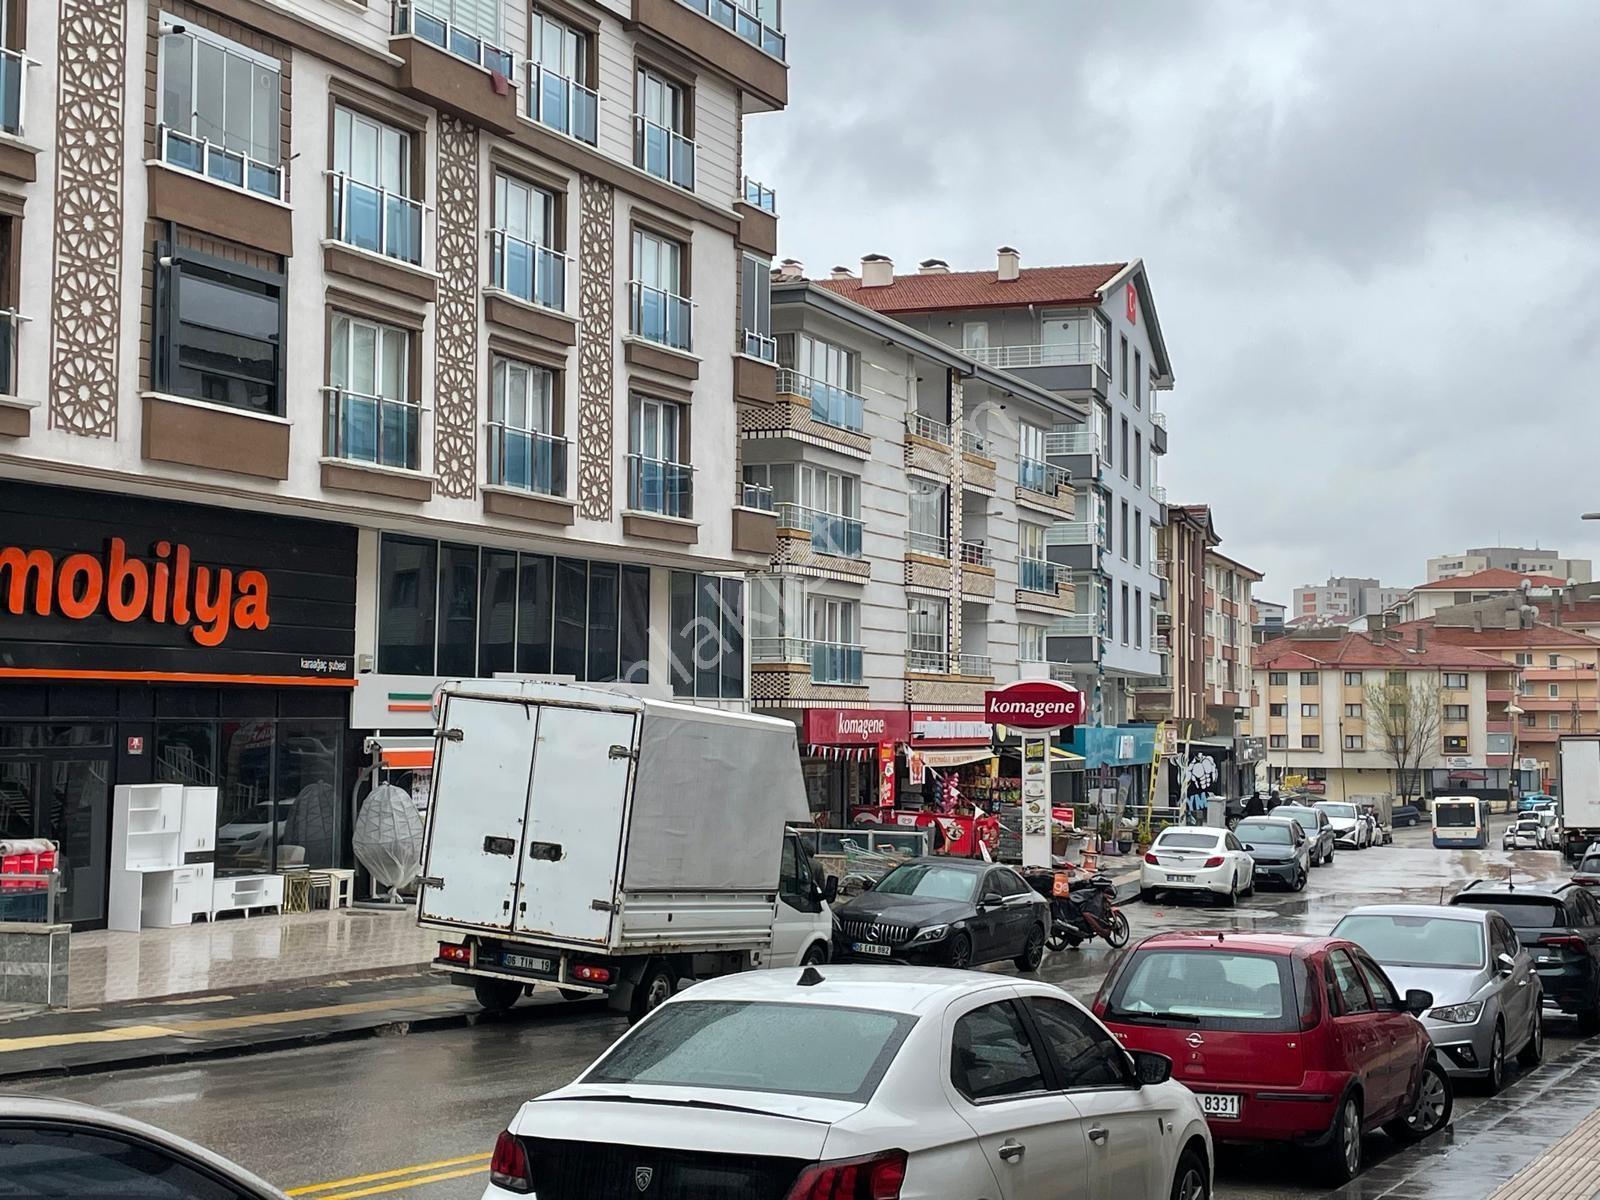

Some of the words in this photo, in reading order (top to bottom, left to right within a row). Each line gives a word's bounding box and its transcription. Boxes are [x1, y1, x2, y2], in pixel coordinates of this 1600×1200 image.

[0, 537, 271, 647] mobilya
[328, 659, 347, 673] şubesi
[990, 697, 1075, 718] komagene
[838, 712, 885, 740] komagene
[541, 960, 550, 971] 19
[1204, 1095, 1235, 1112] 8331
